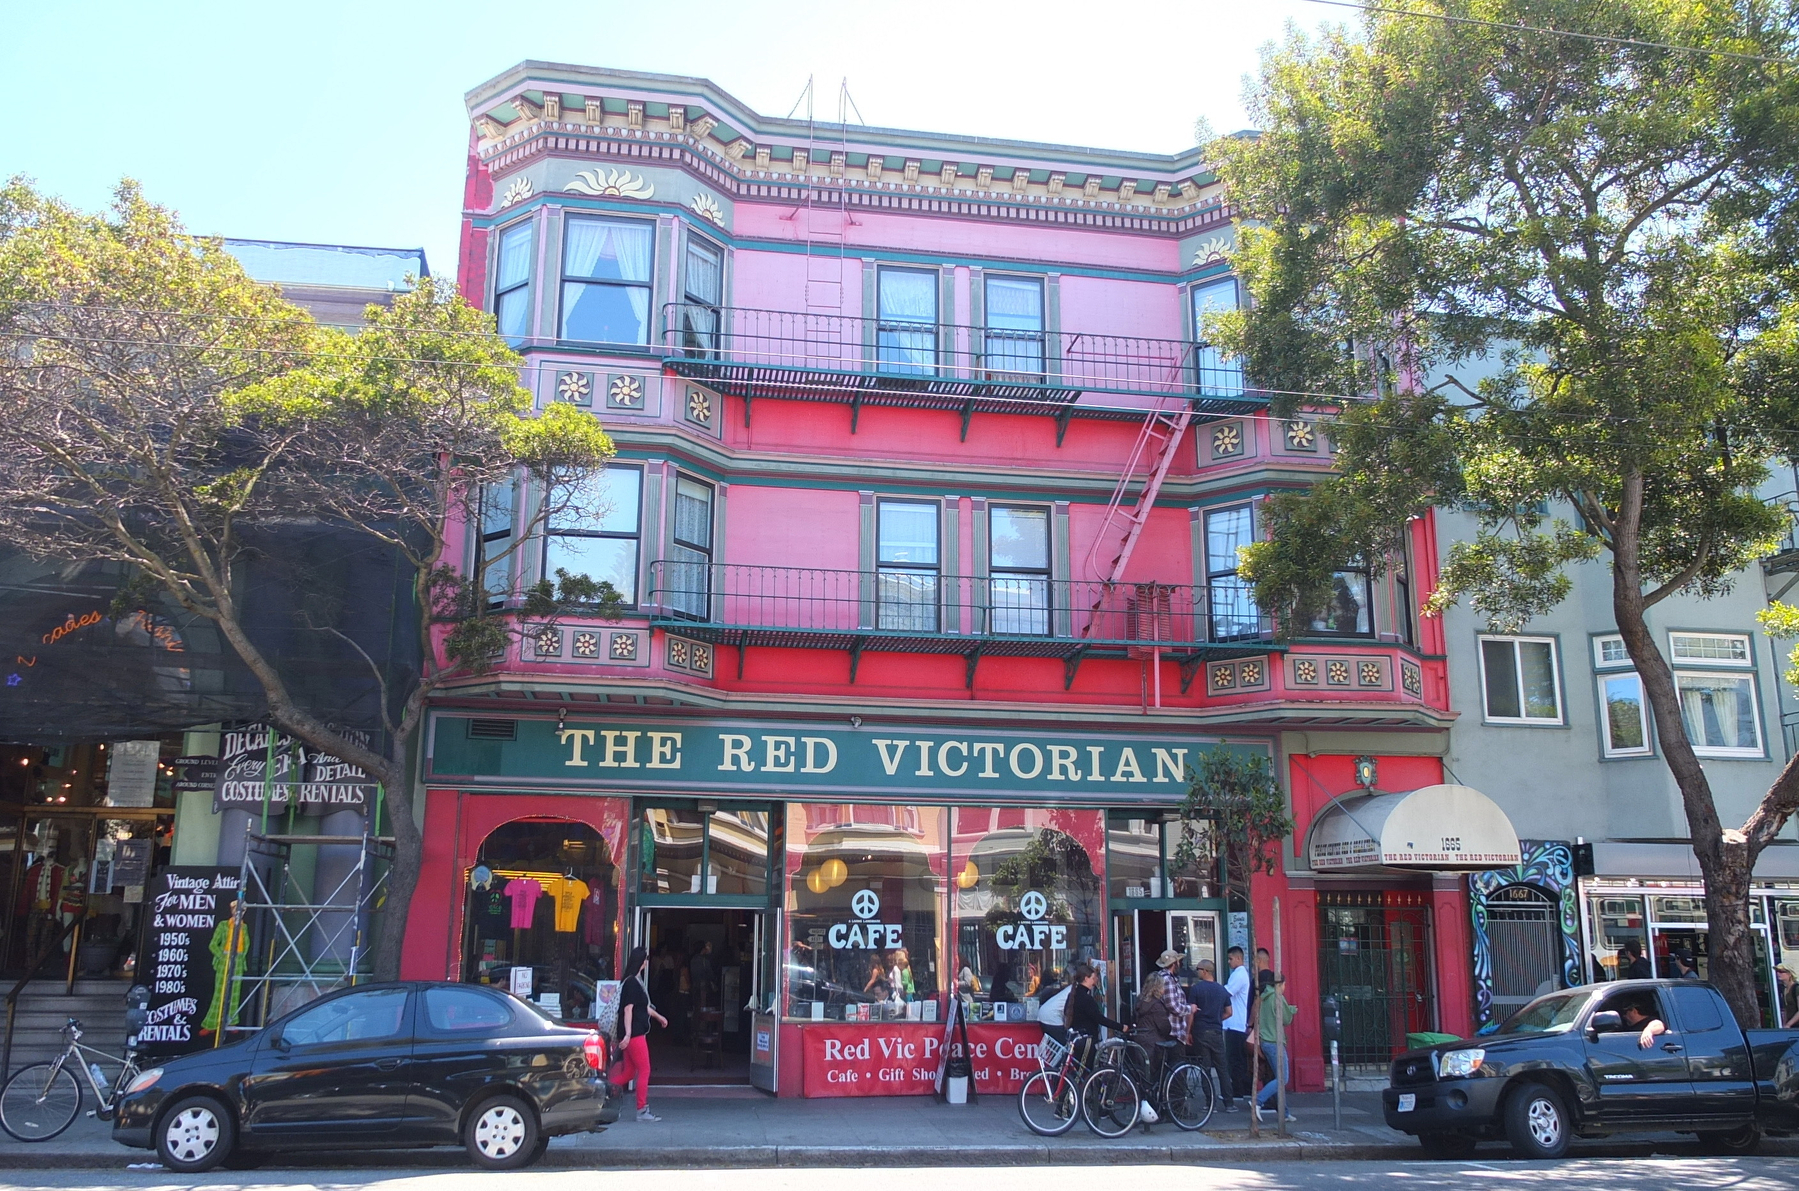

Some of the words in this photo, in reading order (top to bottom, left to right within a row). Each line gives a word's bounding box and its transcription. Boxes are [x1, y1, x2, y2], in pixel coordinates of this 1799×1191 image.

[561, 729, 683, 769] THE
[717, 734, 839, 774] RED
[871, 738, 1188, 783] VICTORIAN
[225, 754, 267, 780] Every
[314, 763, 367, 782] DETAIL
[299, 784, 365, 804] RENTALS
[1441, 837, 1461, 851] 1665
[1384, 853, 1397, 861] THE
[1399, 853, 1413, 861] RED
[1414, 853, 1450, 861] VICTORIAN
[1455, 853, 1468, 861] THE
[1469, 853, 1483, 861] RED
[1484, 853, 1519, 861] VICTORIAN
[166, 873, 211, 893] Vintage
[212, 872, 241, 889] Attir
[155, 891, 180, 913] For
[178, 894, 217, 910] MEN
[1509, 889, 1528, 899] 1667
[153, 914, 165, 928] &
[165, 914, 216, 928] WOMEN
[159, 932, 190, 947] 1950's
[828, 924, 903, 950] CAFE
[996, 925, 1068, 950] CAFE
[157, 948, 189, 963] 1960's
[156, 964, 188, 979] 1970's
[154, 980, 186, 994] 1980's
[173, 1013, 187, 1025] &
[138, 1025, 191, 1042] RENTALS
[823, 1037, 870, 1061] Red
[877, 1036, 915, 1060] Vic
[994, 1035, 1041, 1060] Cen
[827, 1068, 858, 1084] Cafe
[878, 1067, 906, 1083] Gift
[912, 1066, 937, 1083] Sho
[973, 1065, 990, 1082] ed
